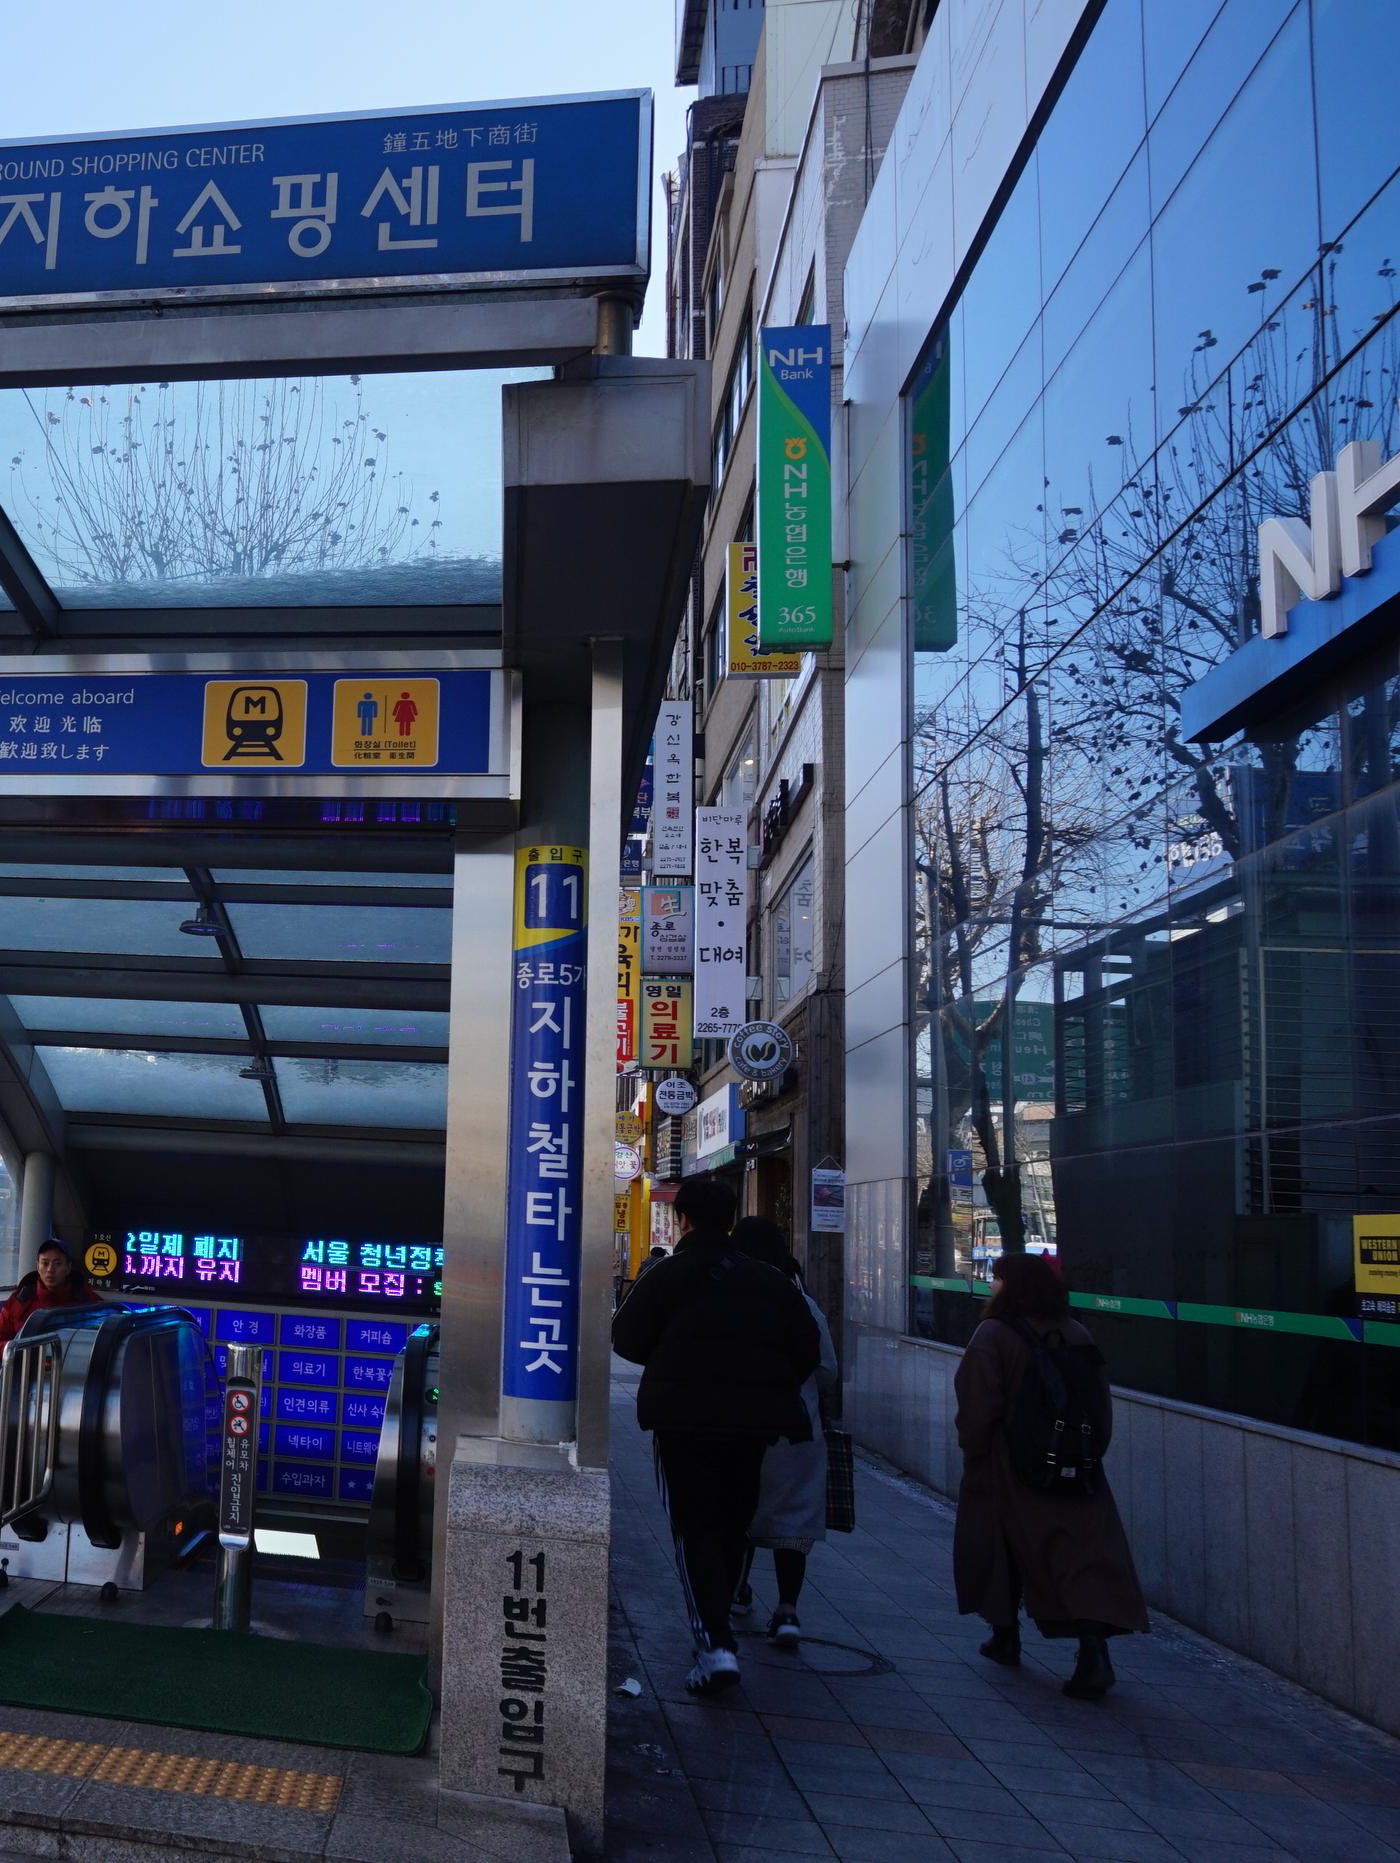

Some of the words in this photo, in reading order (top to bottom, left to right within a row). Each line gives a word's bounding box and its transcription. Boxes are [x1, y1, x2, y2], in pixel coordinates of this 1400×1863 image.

[71, 149, 179, 176] SHOPPING
[186, 144, 265, 166] CENTER
[768, 347, 823, 367] NH
[780, 368, 814, 380] Bank
[778, 604, 817, 627] 365
[731, 661, 799, 671] 010-3787-2323
[71, 687, 135, 705] aboard
[8, 715, 103, 735] 欢迎光临
[354, 740, 381, 749] 화장실
[527, 846, 584, 863] 출입구
[700, 837, 745, 865] 한복
[529, 873, 578, 928] 11
[700, 878, 744, 908] 맞춤
[650, 921, 676, 937] 종로
[699, 946, 744, 964] 대여
[516, 962, 586, 989] 종로5가
[645, 985, 682, 998] 영일
[711, 1006, 731, 1019] 2층
[650, 1000, 680, 1065] 의료기
[194, 1235, 240, 1261] 폐지
[302, 1240, 349, 1265] 서울
[1361, 1239, 1398, 1250] WESTERN
[1372, 1250, 1398, 1261] UNION
[195, 1258, 241, 1283] 유지
[301, 1267, 347, 1292] 멤버
[358, 1272, 404, 1297] 모집
[293, 1325, 327, 1340] 화장품
[292, 1361, 326, 1376] 의료기
[284, 1398, 330, 1414] 인견의류
[347, 1403, 368, 1417] 신사
[288, 1434, 323, 1448] 넥타이
[281, 1473, 326, 1488] 수입과자
